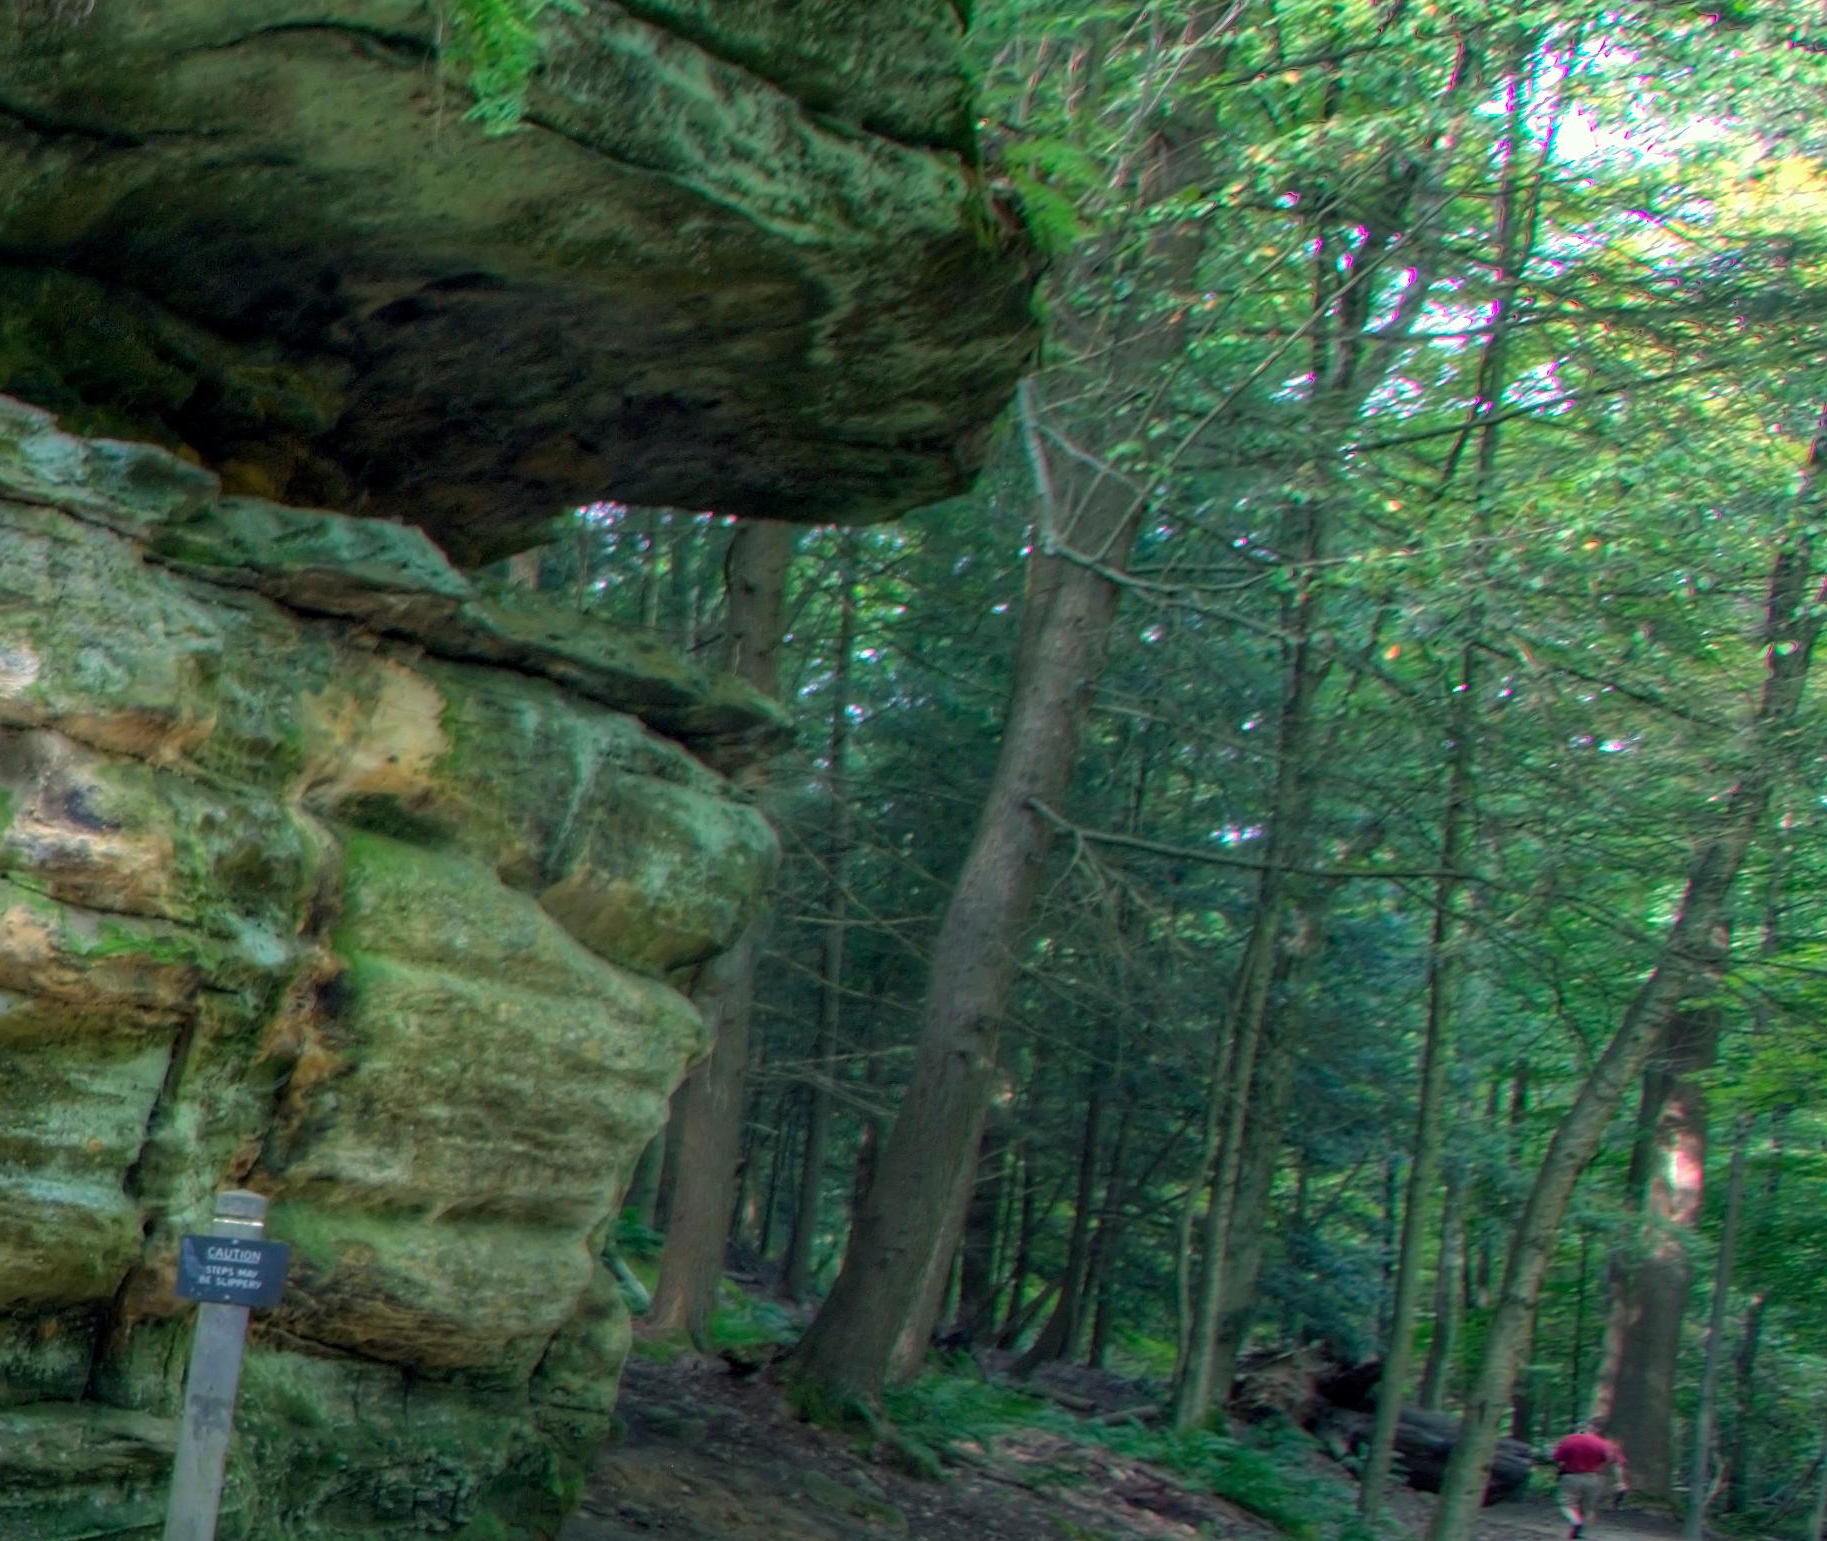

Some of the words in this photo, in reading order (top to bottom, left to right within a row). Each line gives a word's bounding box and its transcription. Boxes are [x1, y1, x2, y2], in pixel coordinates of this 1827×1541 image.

[208, 1246, 262, 1263] CAUTION
[206, 1265, 234, 1276] STEPS
[237, 1268, 260, 1278] MAY
[199, 1275, 211, 1284] BE
[216, 1277, 263, 1289] SLIPPERY
